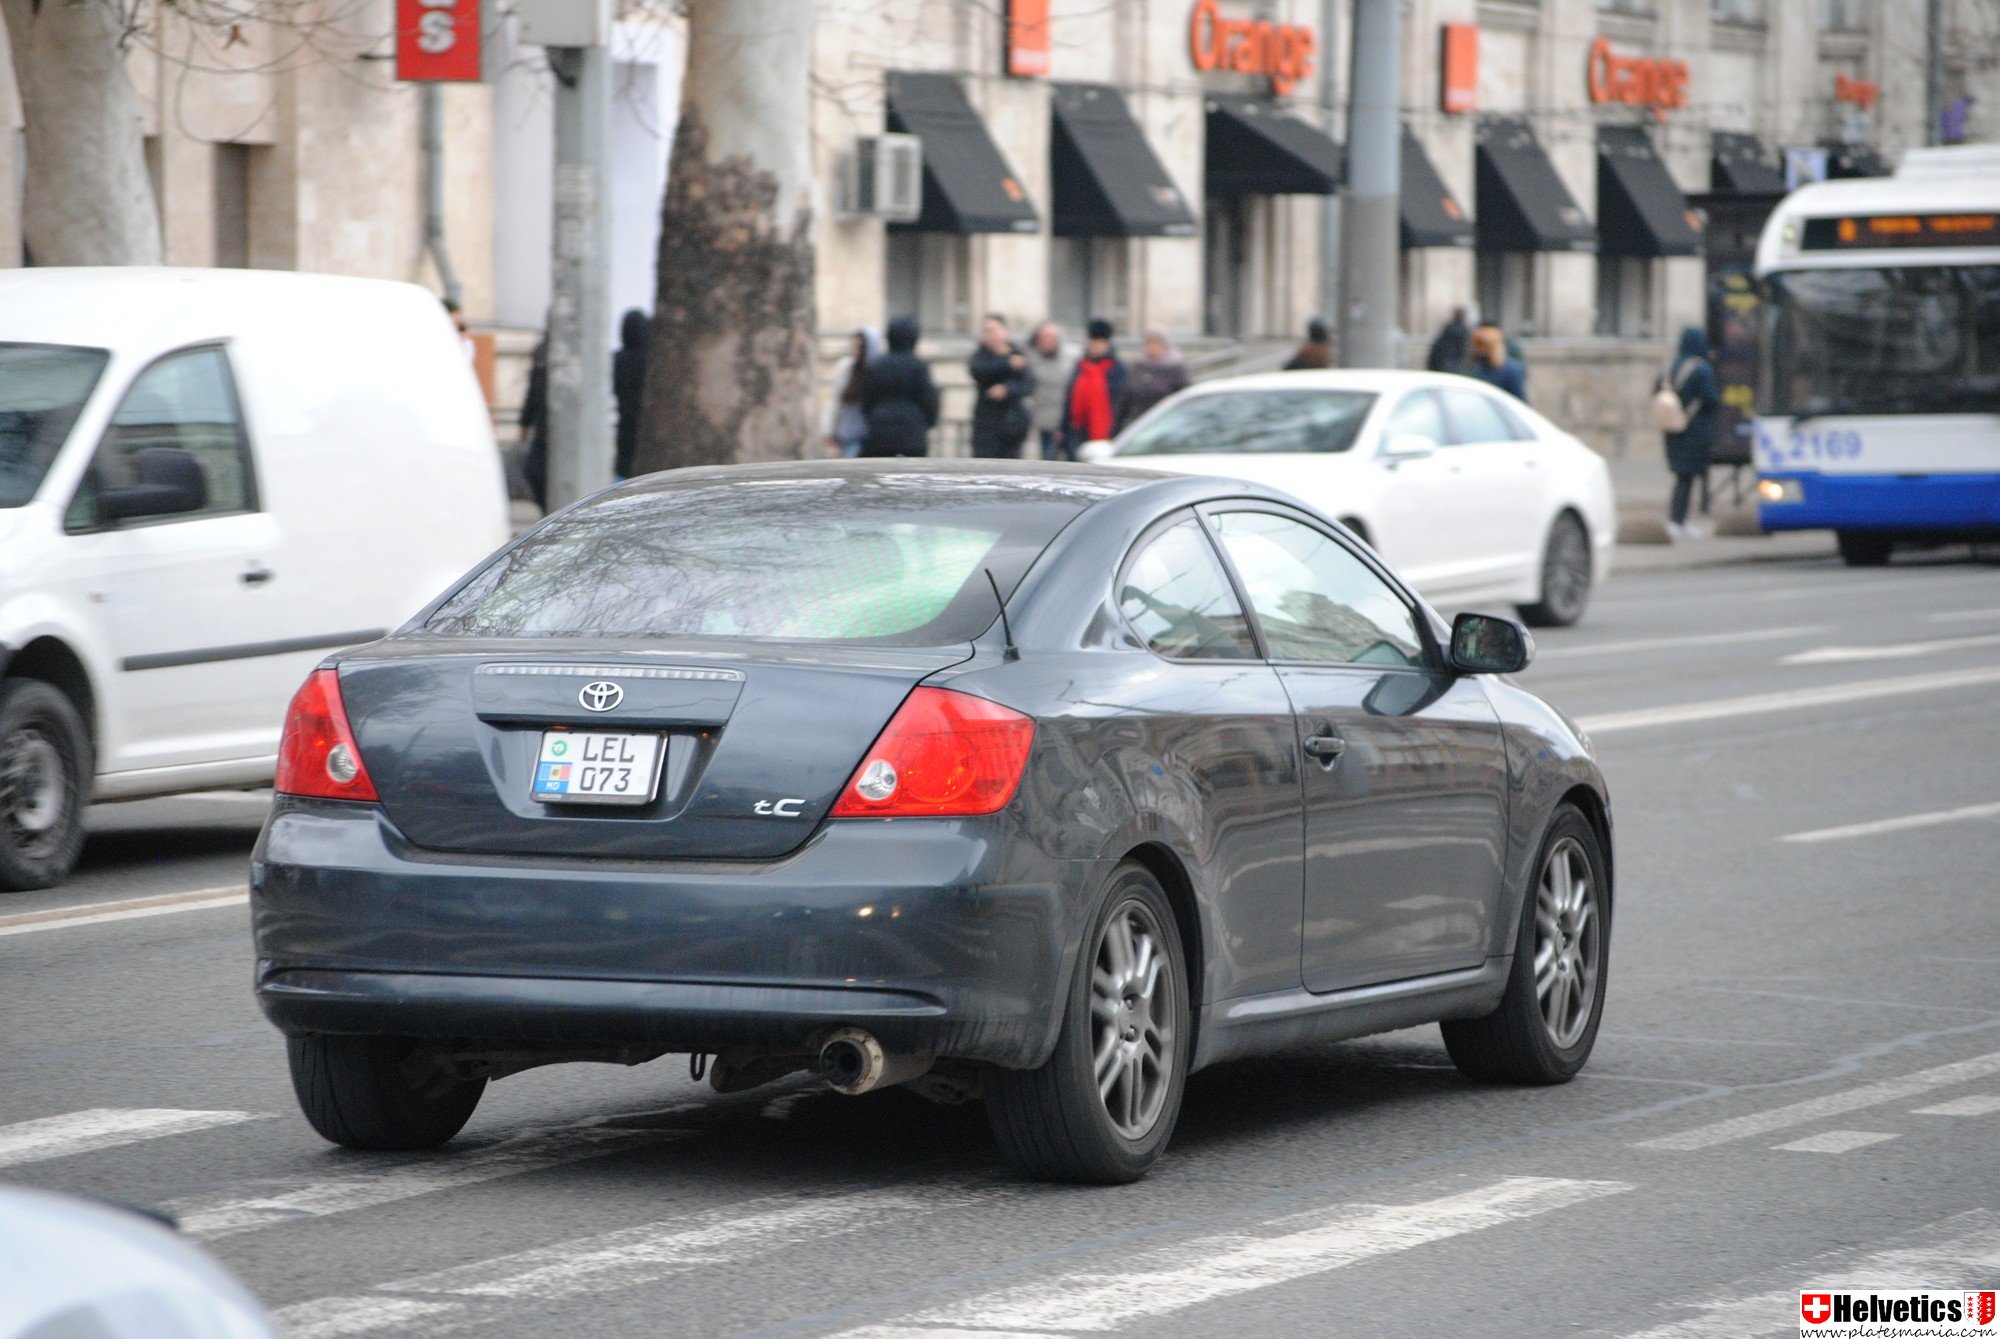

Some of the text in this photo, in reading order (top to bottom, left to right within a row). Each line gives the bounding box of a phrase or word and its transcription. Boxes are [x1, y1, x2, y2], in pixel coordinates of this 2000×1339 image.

[1190, 0, 1314, 96] Orange
[1789, 431, 1862, 458] 2169
[583, 737, 635, 762] LEL
[580, 767, 632, 792] 073
